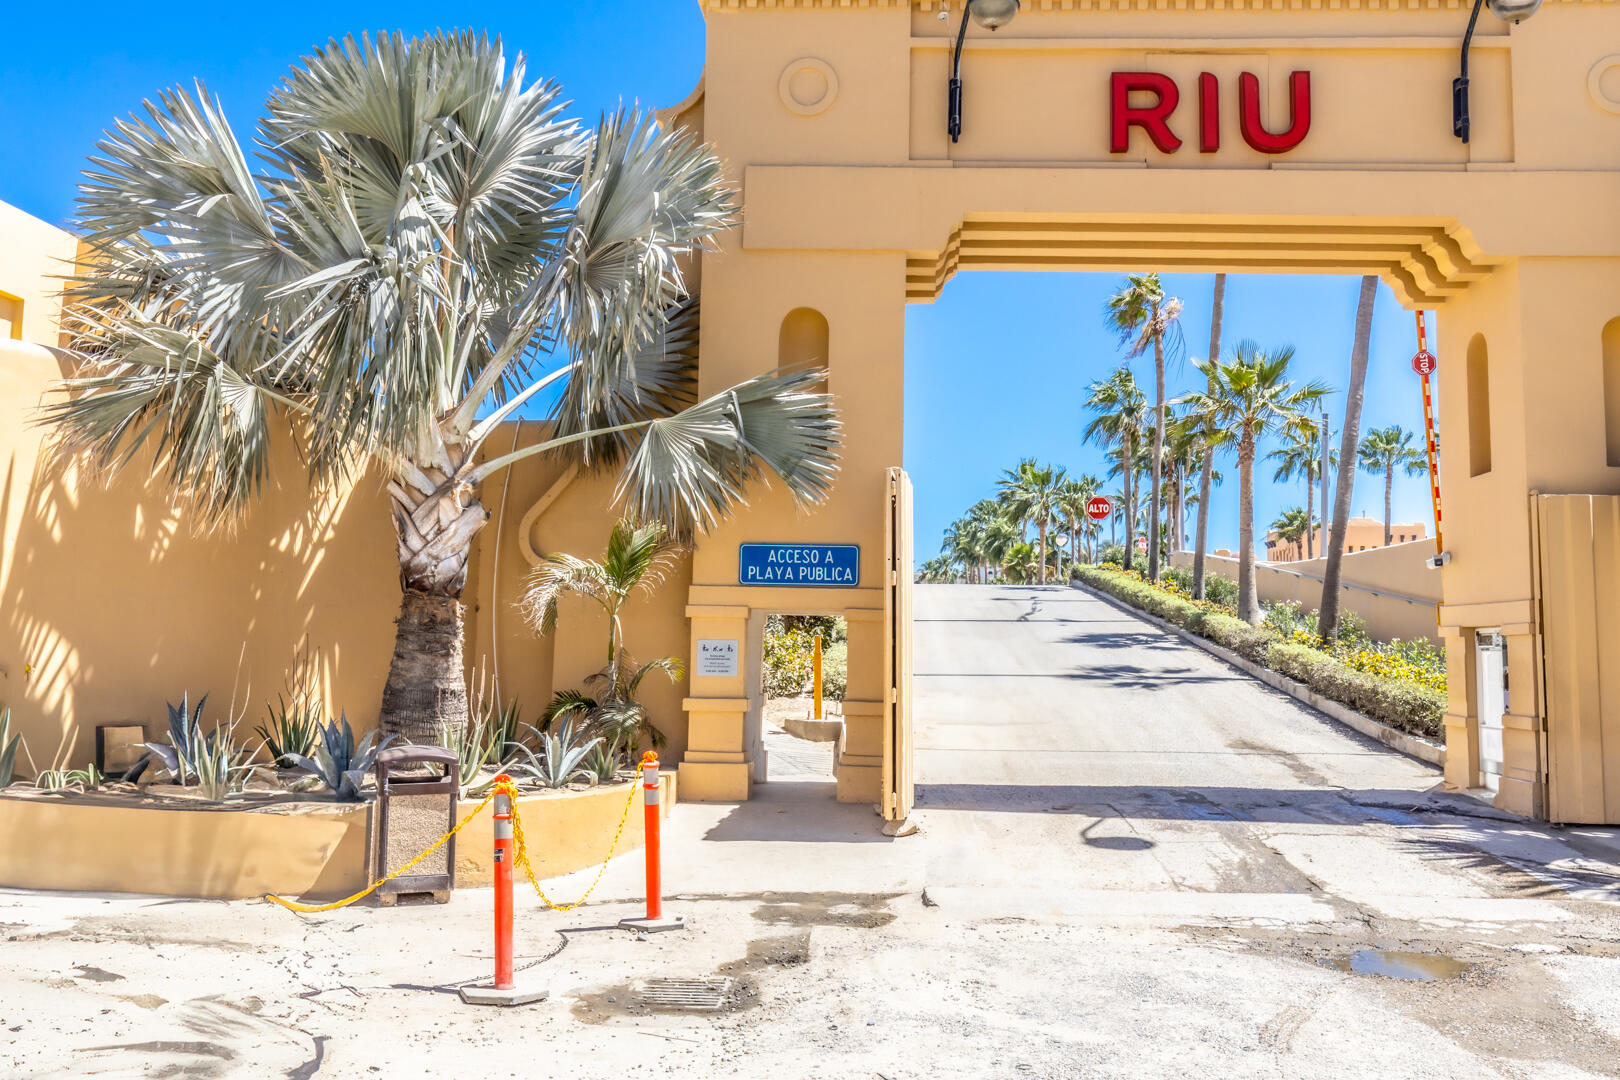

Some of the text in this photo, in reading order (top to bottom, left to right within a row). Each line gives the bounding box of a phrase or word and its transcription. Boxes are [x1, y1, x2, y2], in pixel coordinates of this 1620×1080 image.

[1110, 71, 1311, 154] RIU
[1419, 353, 1430, 374] STOP
[1088, 503, 1110, 513] ALTO
[768, 549, 834, 564] ACCESO A
[748, 566, 853, 581] PLAYA PUBLICA
